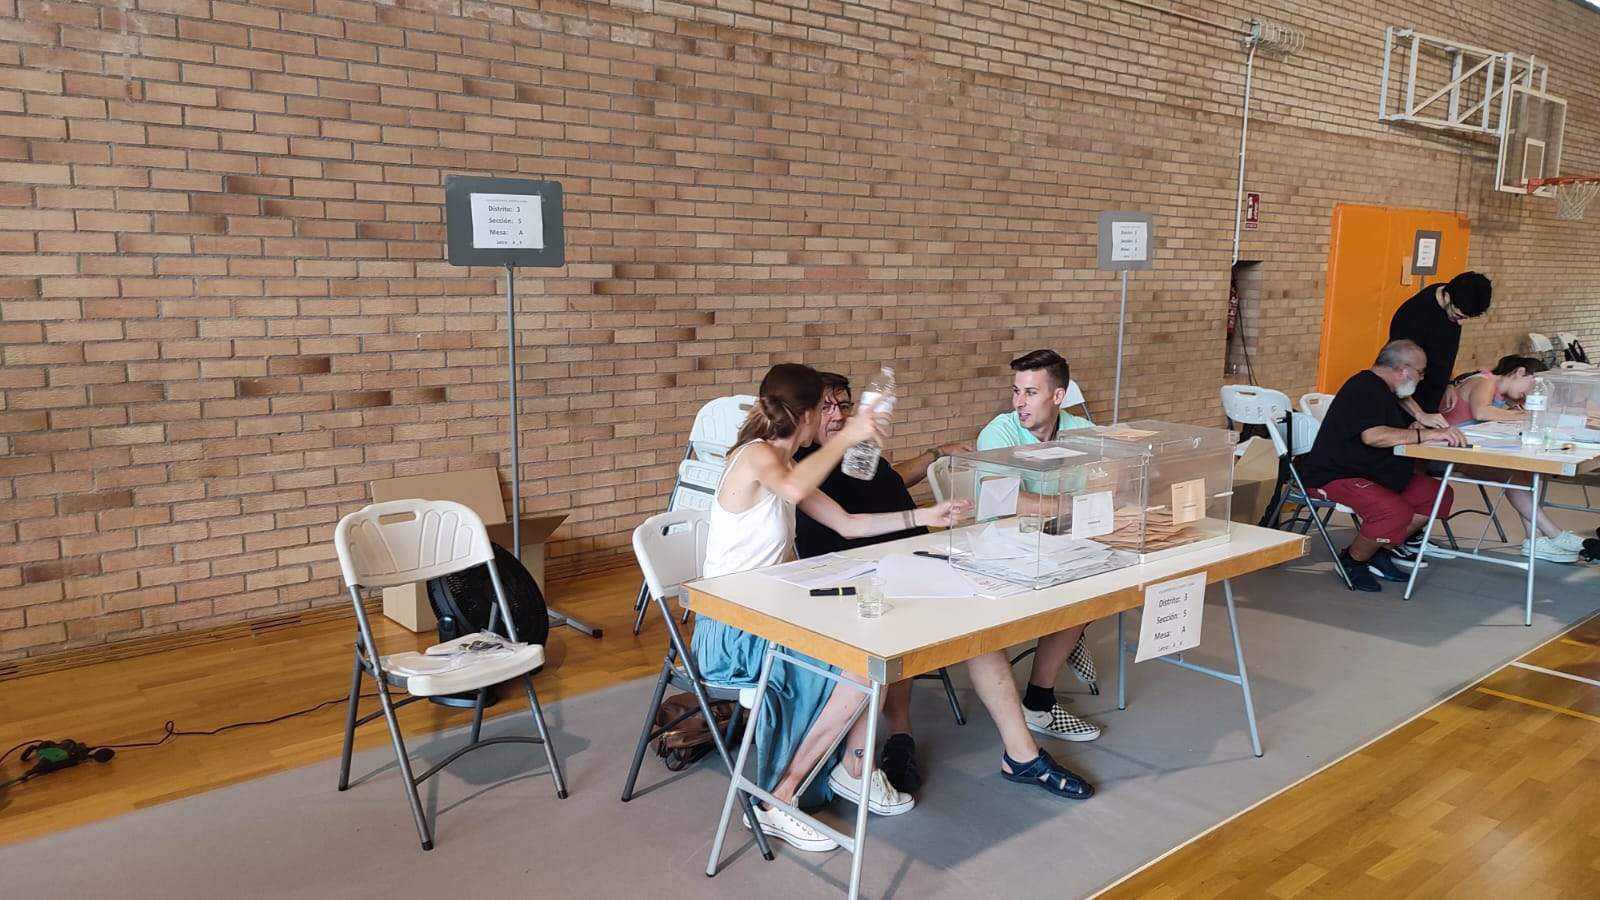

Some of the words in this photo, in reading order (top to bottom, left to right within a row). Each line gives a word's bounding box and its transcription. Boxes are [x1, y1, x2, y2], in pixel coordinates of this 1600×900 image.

[488, 205, 512, 213] Distrito:
[1154, 630, 1171, 640] Mesa:
[1182, 625, 1186, 633] A
